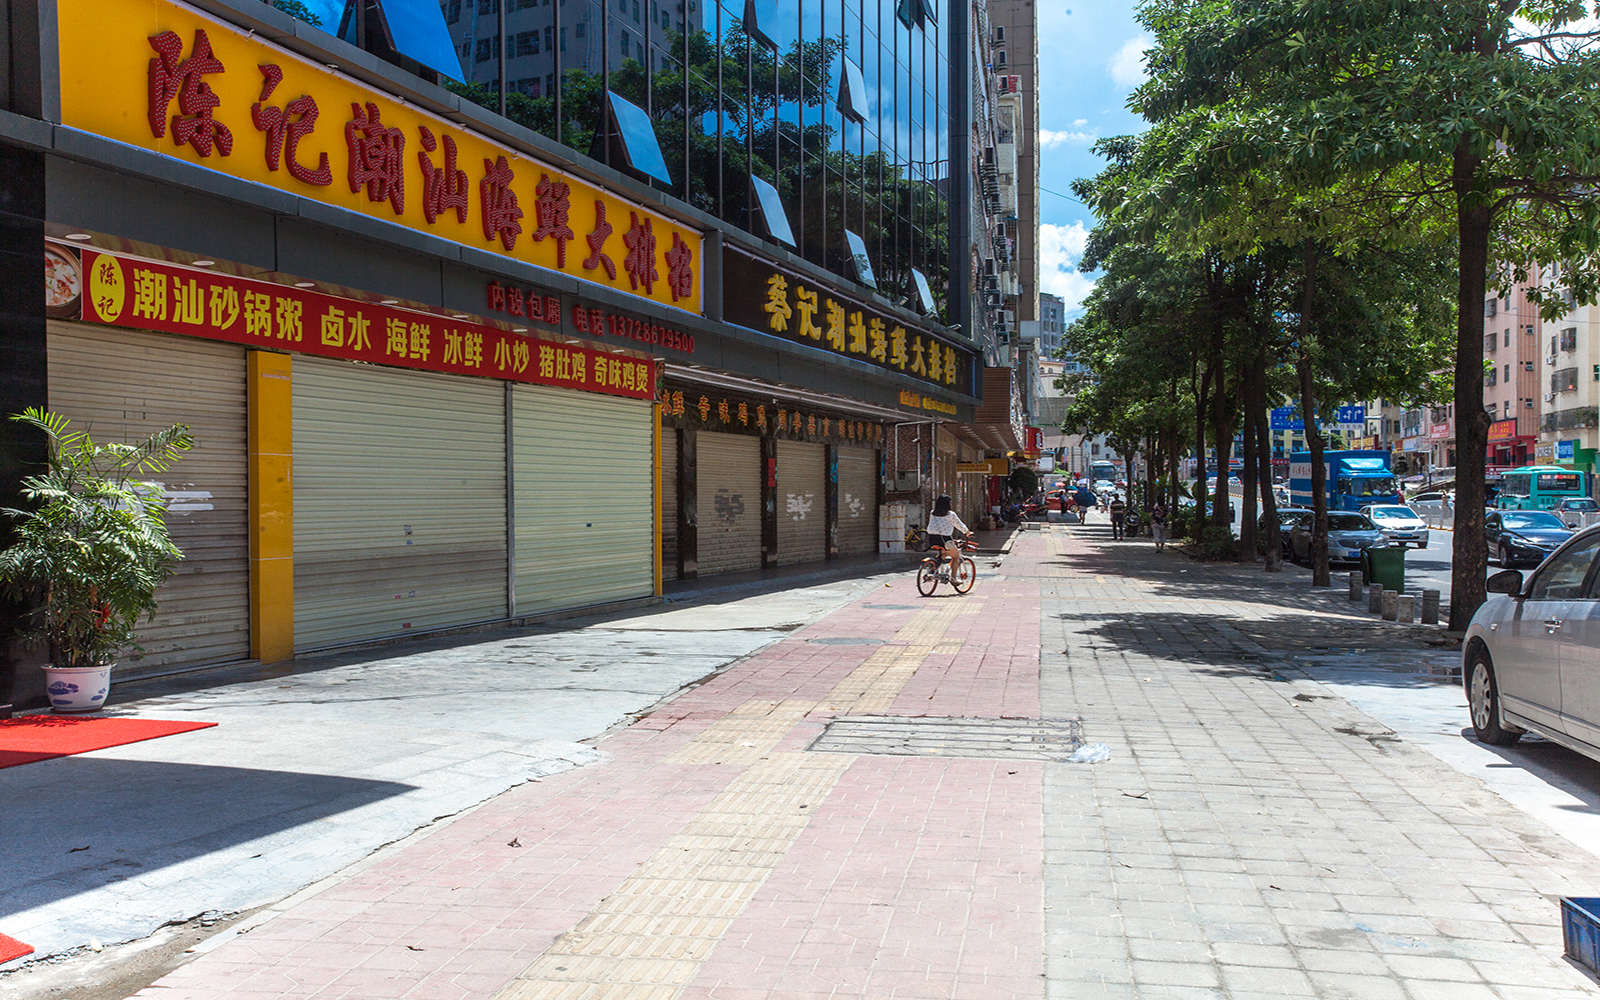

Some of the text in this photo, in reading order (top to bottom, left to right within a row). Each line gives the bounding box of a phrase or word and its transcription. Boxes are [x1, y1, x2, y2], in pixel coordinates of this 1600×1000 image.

[147, 29, 693, 303] 陈记潮汕海鲜大排档
[97, 263, 118, 317] 陈记
[132, 268, 649, 393] 潮汕砂锅粥 卤水 海鲜 冰鲜 小炒 猪肚鸡 奇味鸡煲
[487, 281, 695, 353] 内设包厢 电话 13728679500
[764, 274, 956, 385] 蔡记潮汕海鲜大排档
